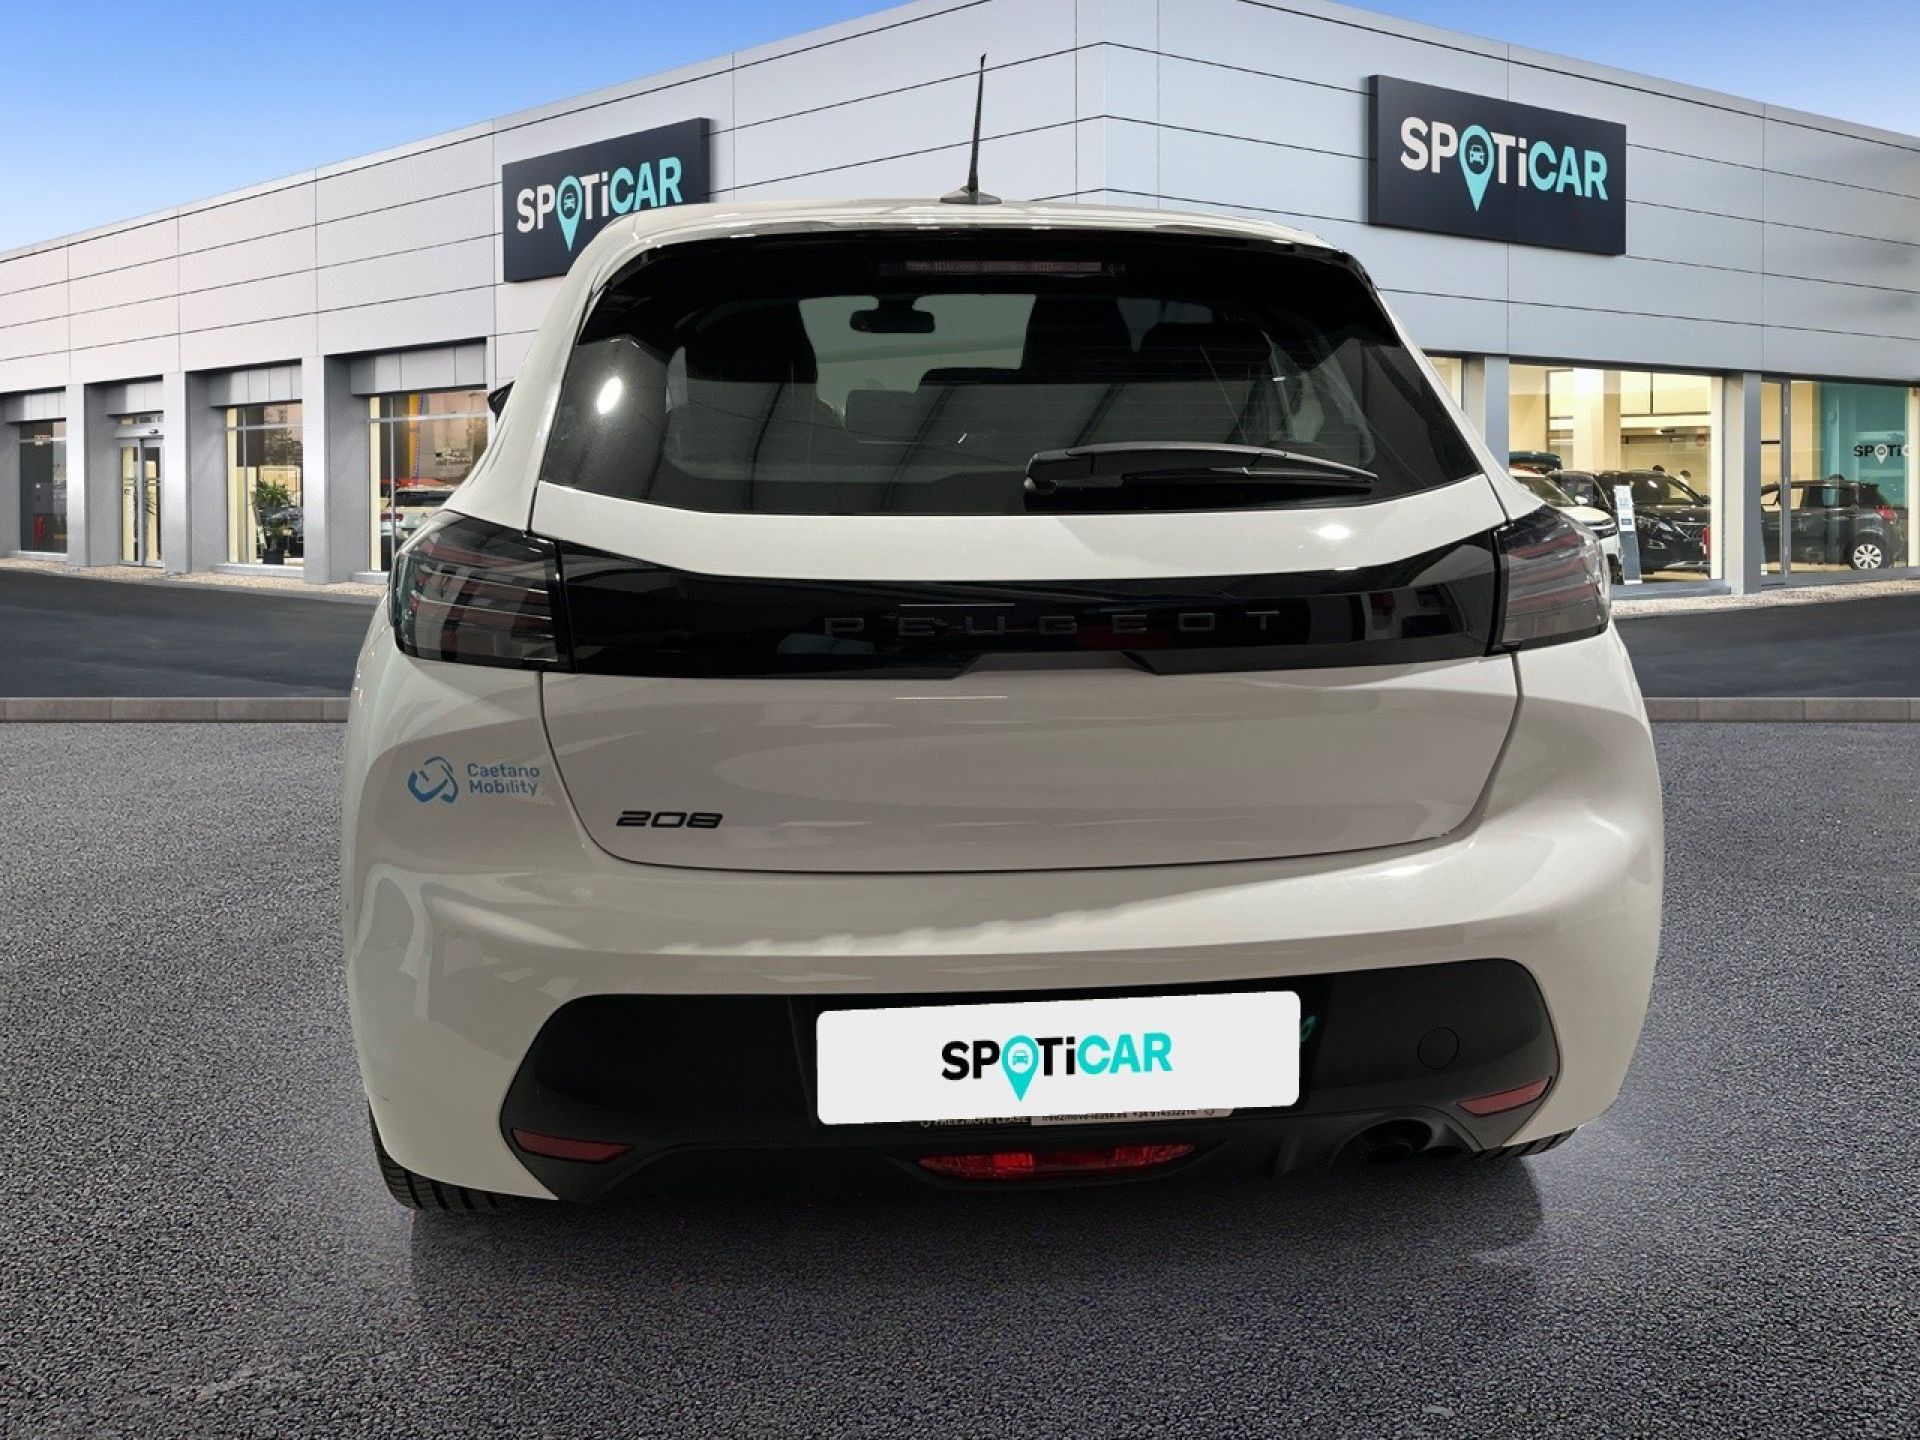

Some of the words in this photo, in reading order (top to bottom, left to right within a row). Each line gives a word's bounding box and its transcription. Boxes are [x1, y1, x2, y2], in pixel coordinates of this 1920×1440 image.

[824, 609, 1281, 637] PEUGEOT
[467, 763, 541, 779] Caetano
[469, 779, 538, 797] Mobility
[616, 810, 724, 830] 208
